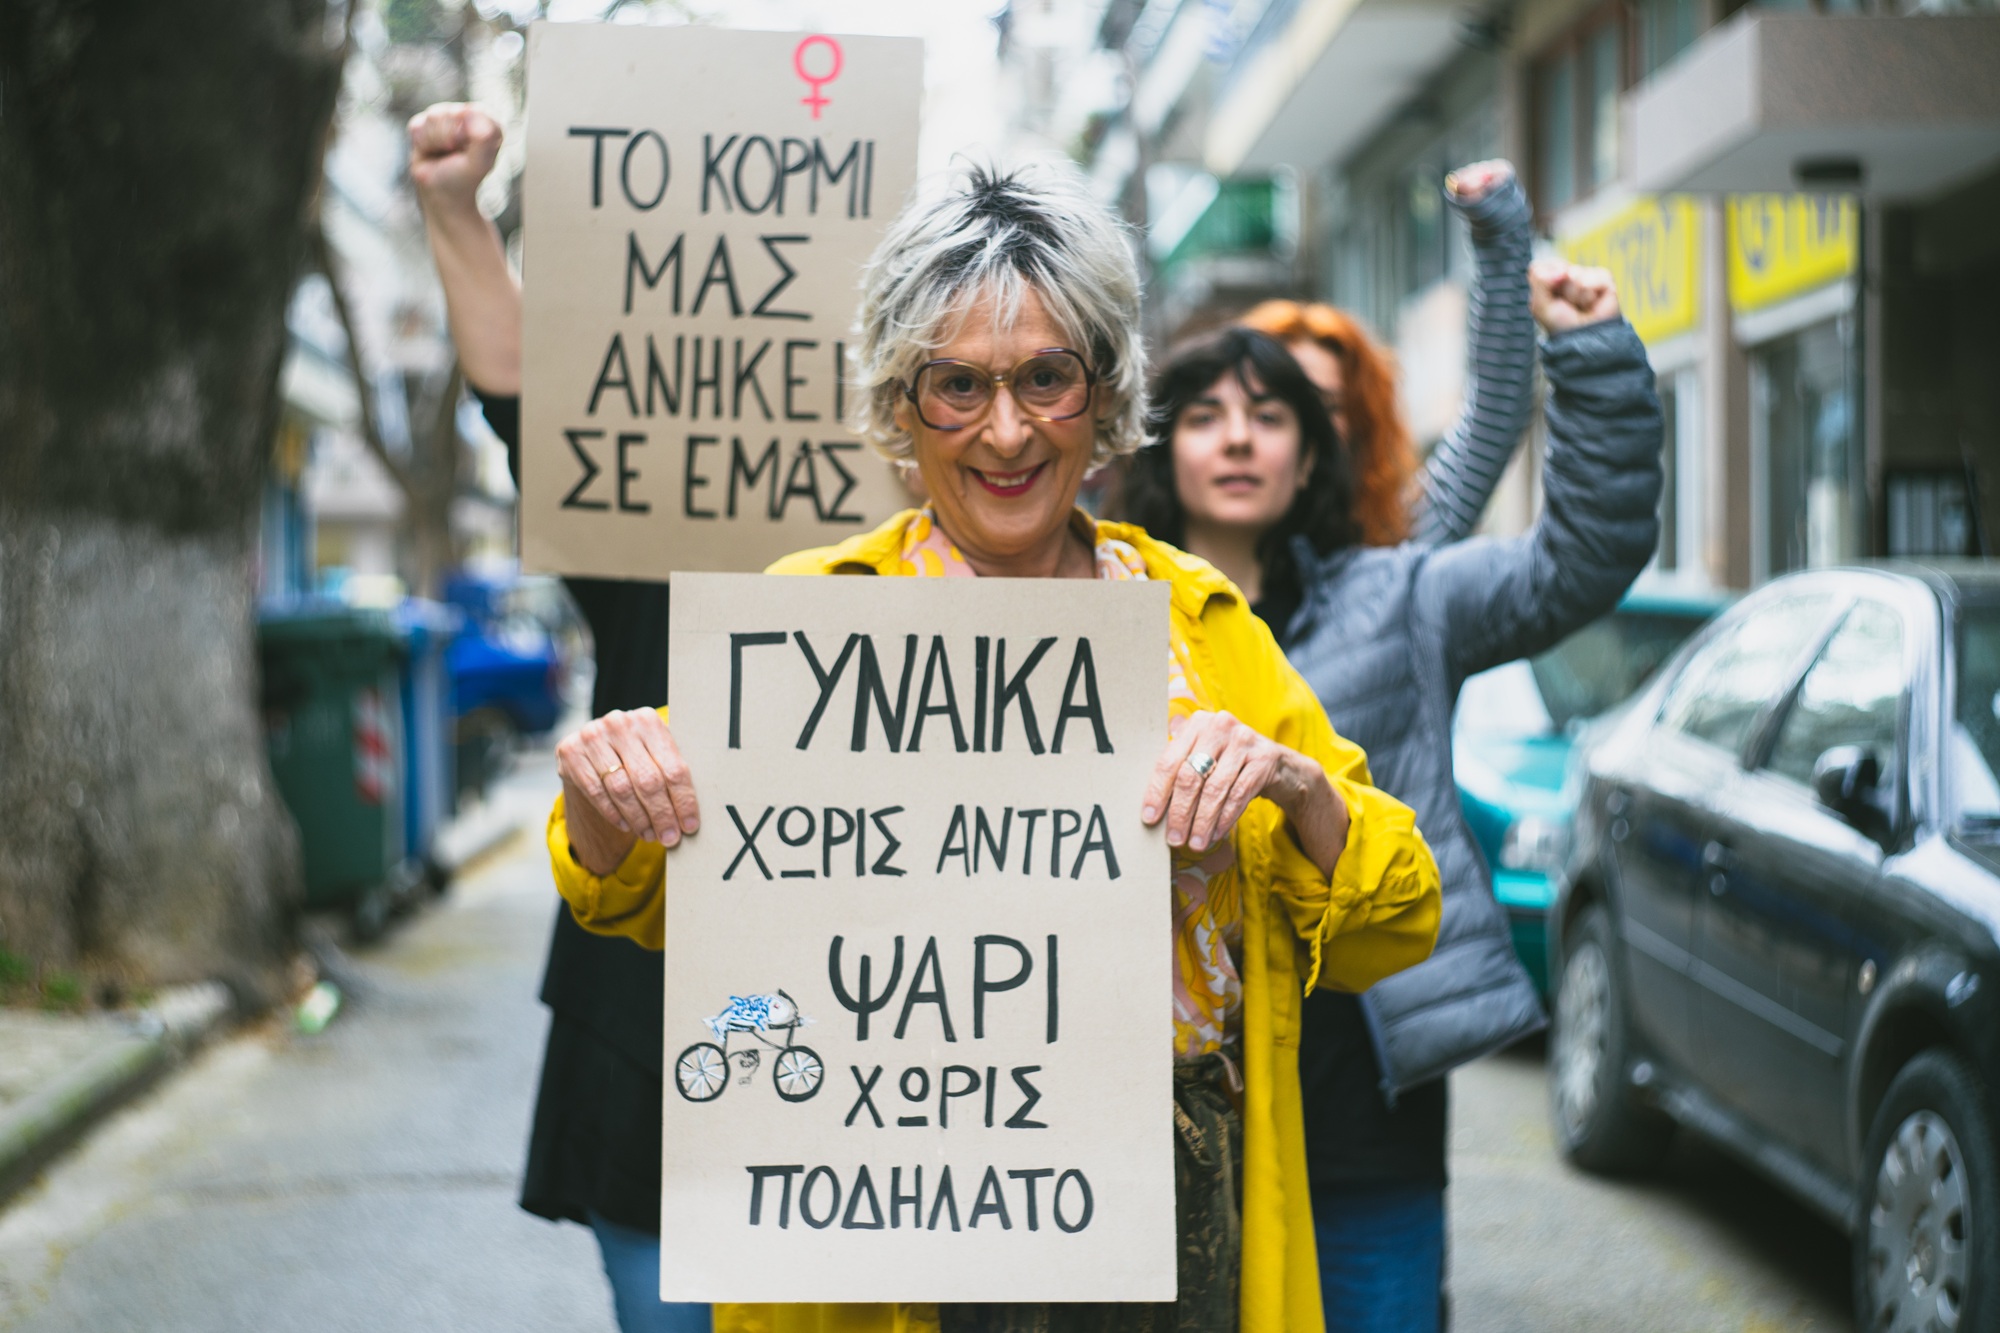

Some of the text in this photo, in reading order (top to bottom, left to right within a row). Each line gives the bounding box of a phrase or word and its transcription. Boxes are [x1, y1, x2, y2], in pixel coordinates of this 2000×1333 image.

[569, 126, 876, 219] ΤΟ ΚΟΡΜΙ
[623, 230, 812, 321] ΜΑΣ
[586, 332, 847, 423] ΑΝΗΚΕΙ
[561, 428, 651, 514] ΣΕ
[728, 630, 1114, 755] ΓΥΝΑΙΚΑ
[723, 804, 1121, 880] ΧΩΡΙΣ ΑΝΤΡΑ
[828, 934, 1058, 1044] ΨΑΡΙ
[845, 1065, 1049, 1129] ΧΩΡΙΣ
[746, 1164, 1094, 1234] ΠΟΔΗΛΑΤΟ
